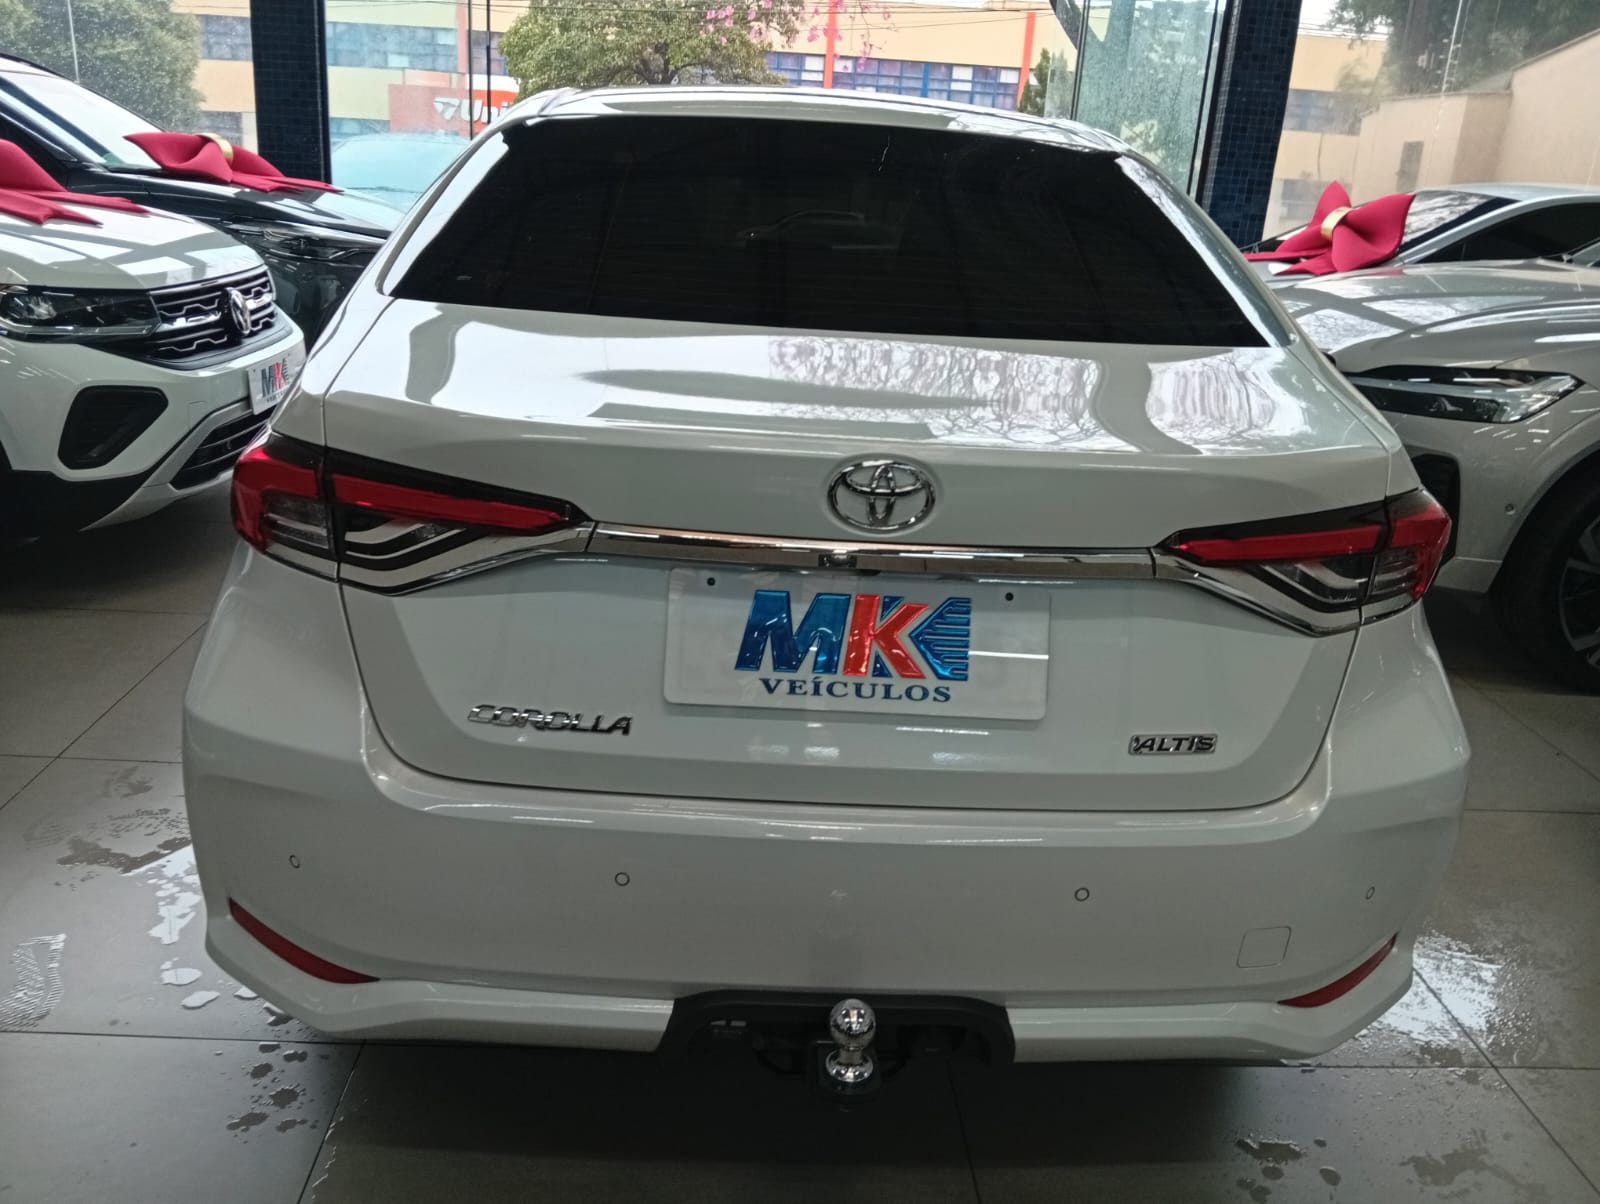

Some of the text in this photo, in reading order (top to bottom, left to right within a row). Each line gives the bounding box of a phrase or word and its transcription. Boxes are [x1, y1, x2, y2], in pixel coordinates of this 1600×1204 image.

[759, 676, 951, 703] VEÍCULOS
[467, 704, 634, 736] COROLLA
[1133, 735, 1216, 753] ALTIS
